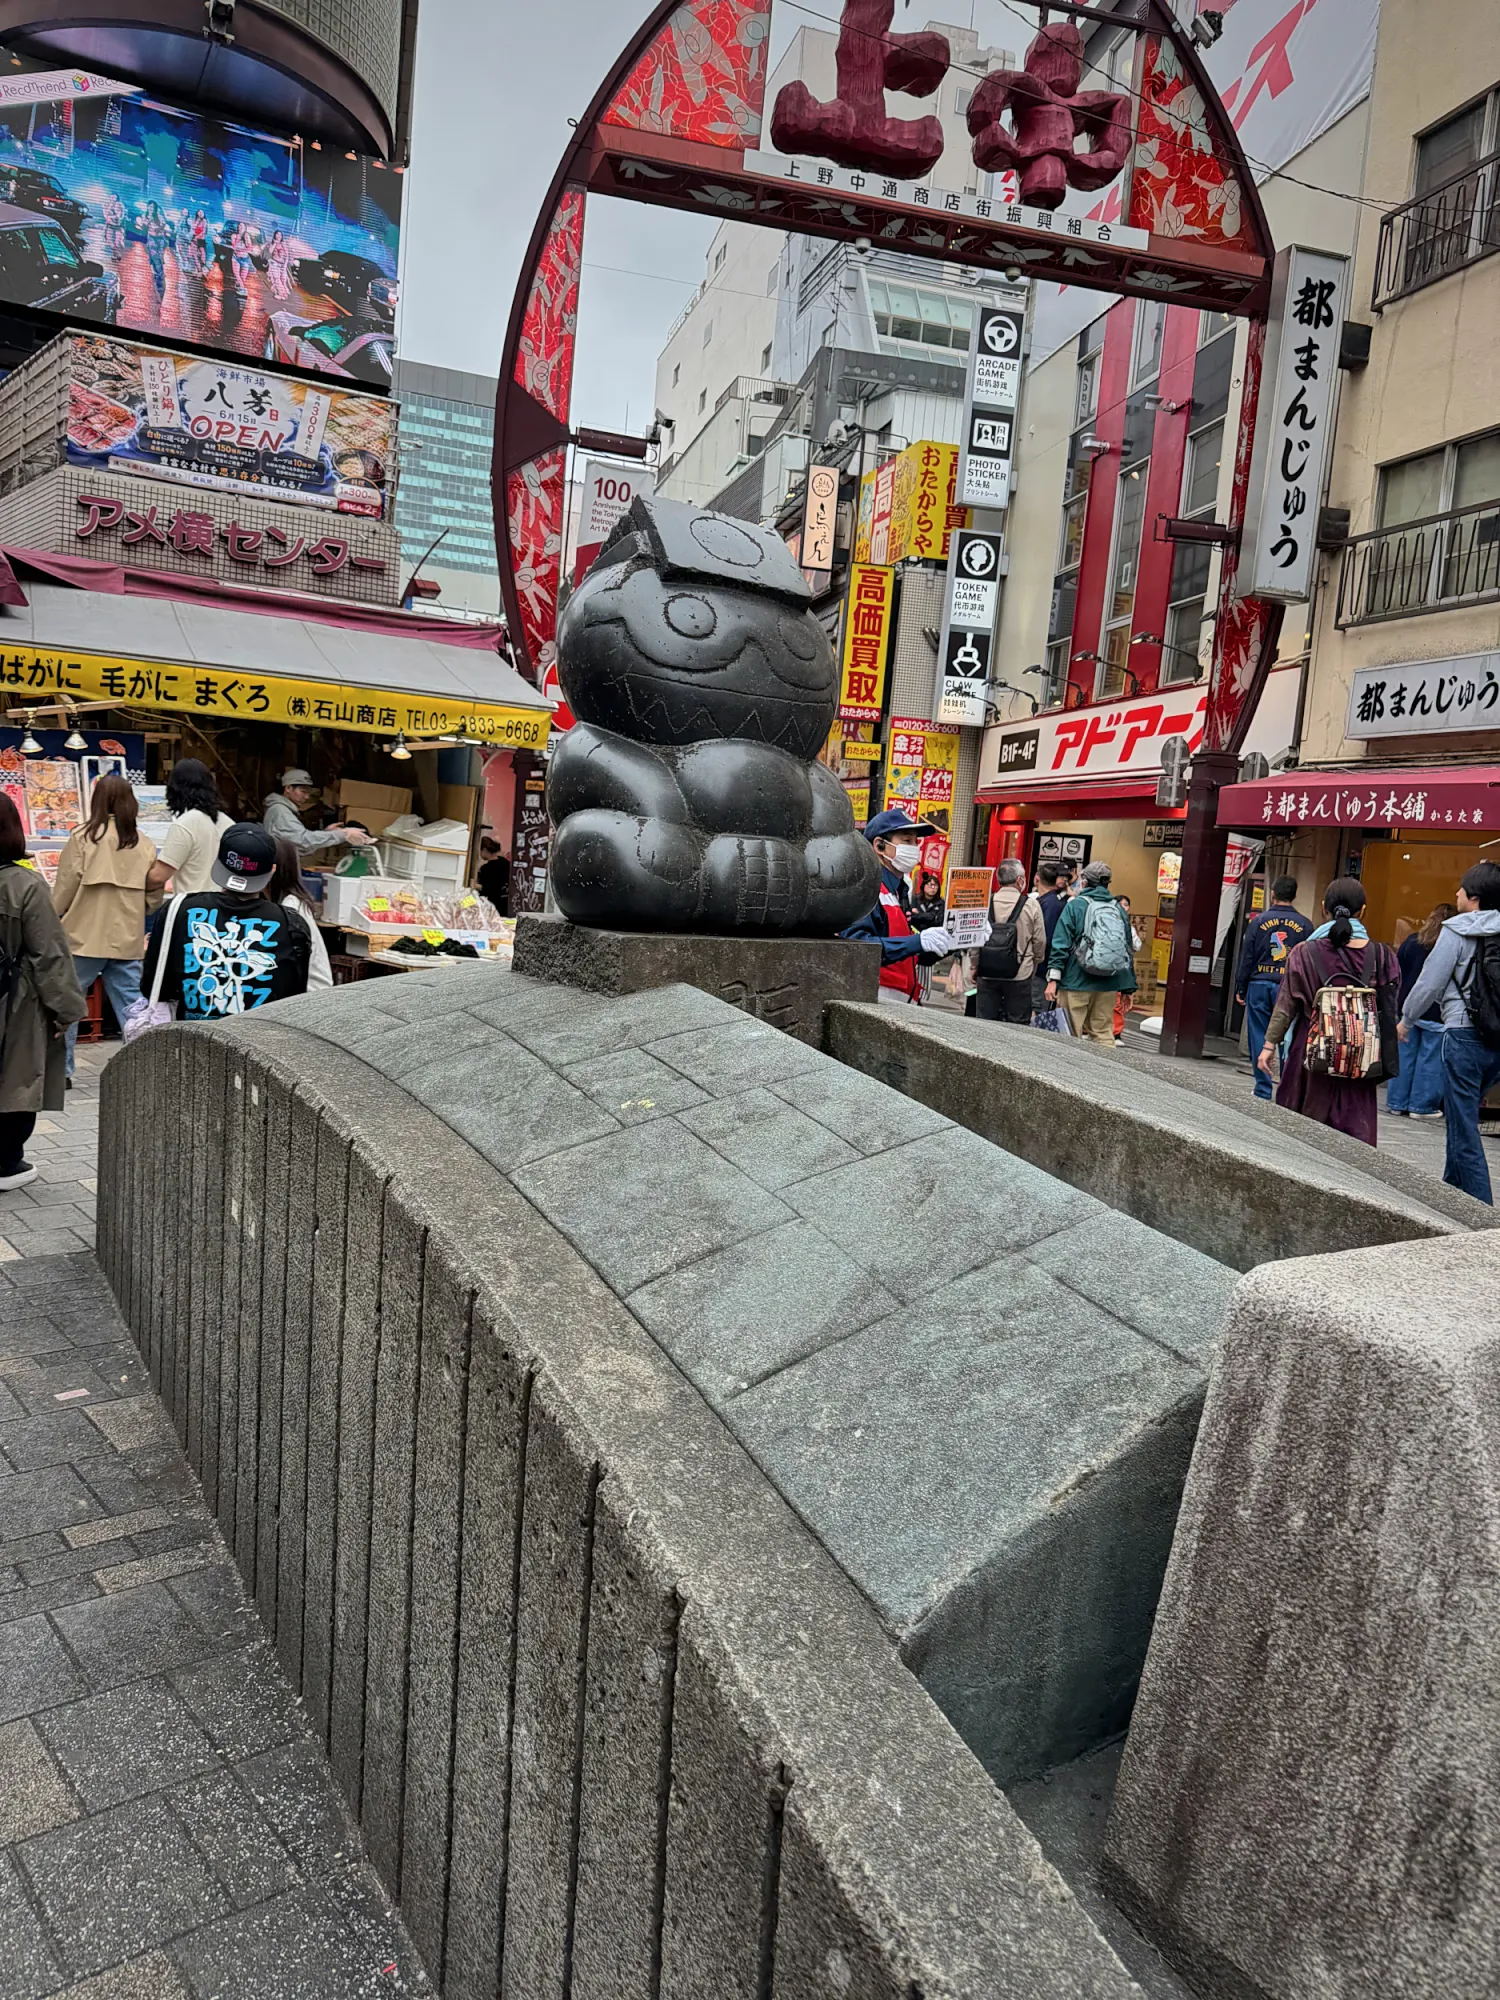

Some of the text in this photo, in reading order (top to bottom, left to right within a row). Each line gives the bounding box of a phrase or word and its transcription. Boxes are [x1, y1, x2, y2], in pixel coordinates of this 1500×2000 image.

[2, 79, 67, 97] Recommend
[784, 159, 1113, 241] 上野中通商店街振興組合
[977, 367, 1006, 380] GAME
[978, 358, 1018, 372] ARCADE
[215, 367, 266, 388] 海鮮市場
[203, 381, 273, 416] 八芳
[1270, 276, 1336, 568] 都まんじゅう
[190, 415, 285, 453] OPEN
[967, 467, 1007, 482] STICKER
[968, 458, 1001, 471] PHOTO
[966, 478, 990, 490] 大头贴
[914, 445, 941, 555] おたからや
[76, 494, 387, 575] アメ横センター
[954, 591, 983, 602] GAME
[956, 582, 988, 593] TOKEN
[846, 567, 889, 705] 高価買取
[0, 654, 82, 689] ばがに
[100, 666, 178, 702] 毛がに
[195, 677, 271, 712] まぐろ
[945, 679, 973, 690] CLAW
[1356, 671, 1500, 723] 都まんじゅう
[840, 706, 880, 720] おたからや
[902, 720, 959, 735] 0120-555-600
[845, 744, 881, 757] おたからや
[893, 735, 909, 752] 金
[1001, 738, 1037, 764] B1F-4F
[923, 769, 953, 789] ダイヤ
[1275, 789, 1428, 823] 都まんじゅう本舗
[182, 978, 272, 1012] BLTZ
